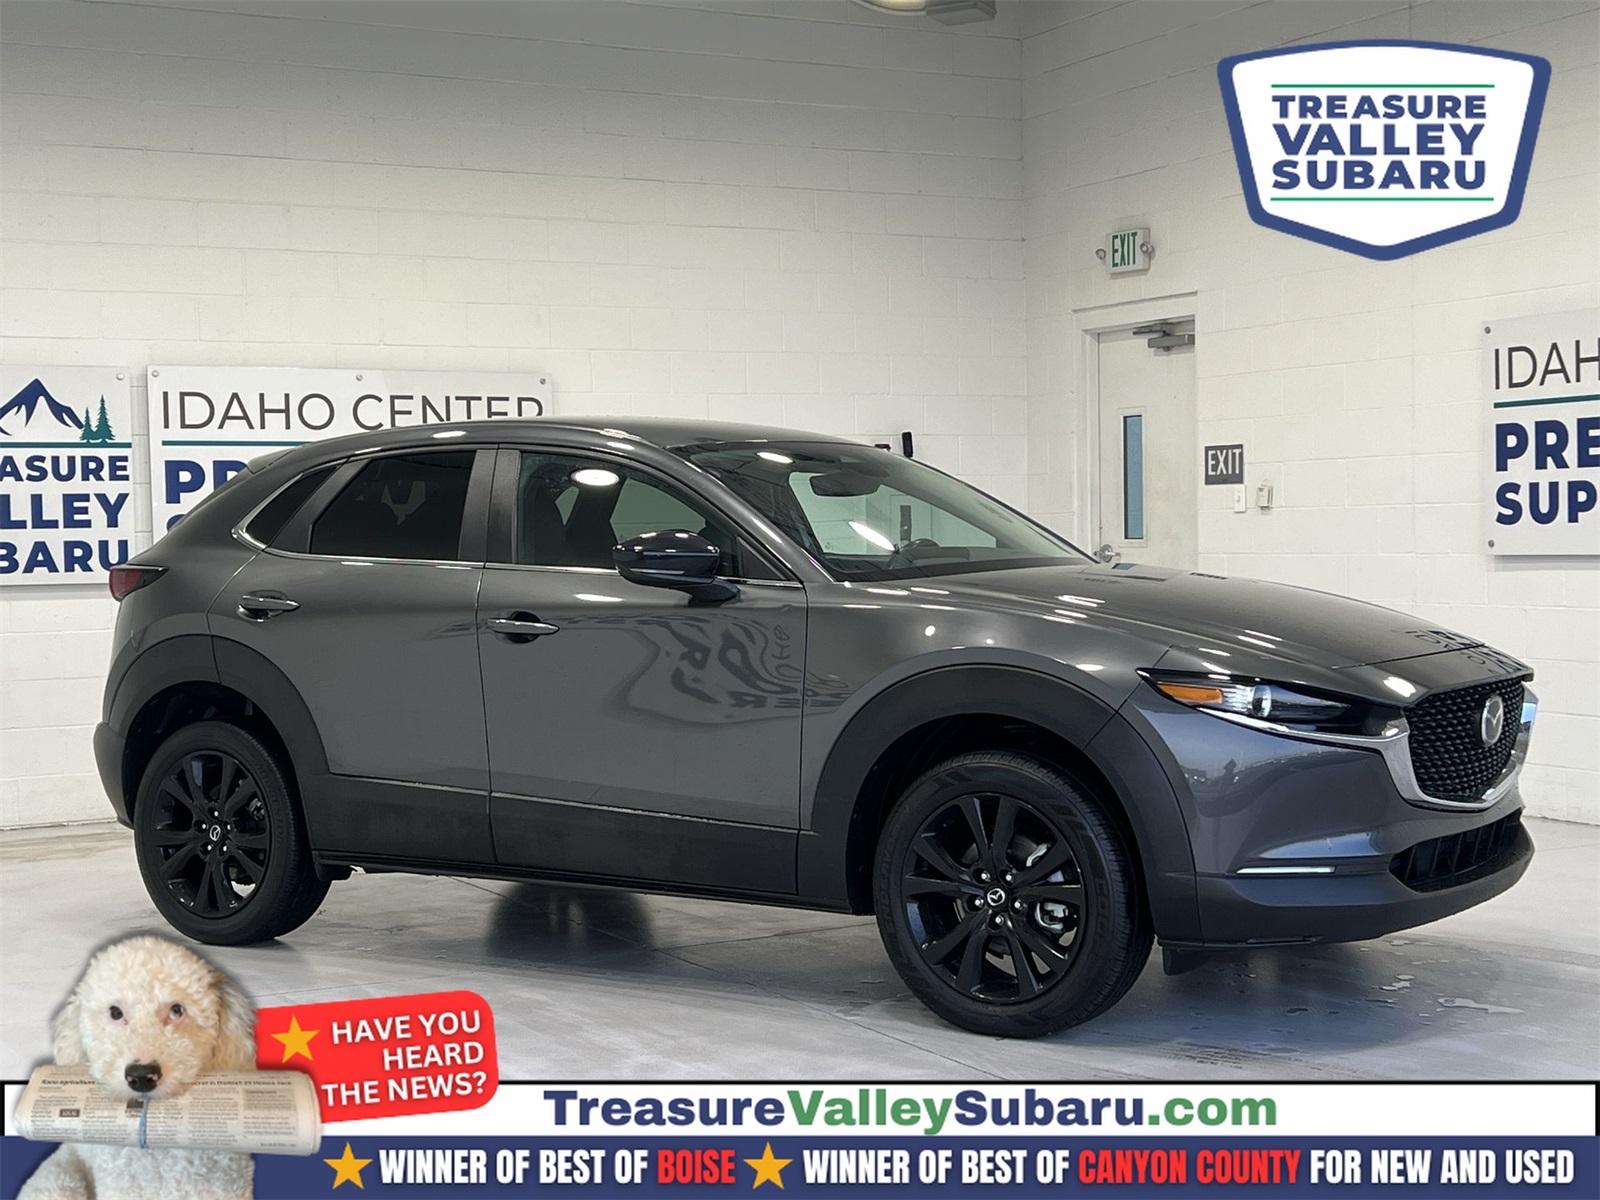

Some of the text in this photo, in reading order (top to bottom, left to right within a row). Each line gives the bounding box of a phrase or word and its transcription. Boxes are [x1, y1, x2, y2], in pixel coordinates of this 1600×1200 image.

[1112, 231, 1138, 268] EXIT
[1495, 338, 1600, 390] IDAH
[162, 391, 335, 431] IDAHO
[1207, 449, 1242, 475] EXIT
[1495, 417, 1600, 472] PRE
[0, 455, 130, 482] ASURE
[0, 493, 130, 529] LLEY
[1495, 480, 1598, 526] SUP
[0, 540, 129, 574] BARU
